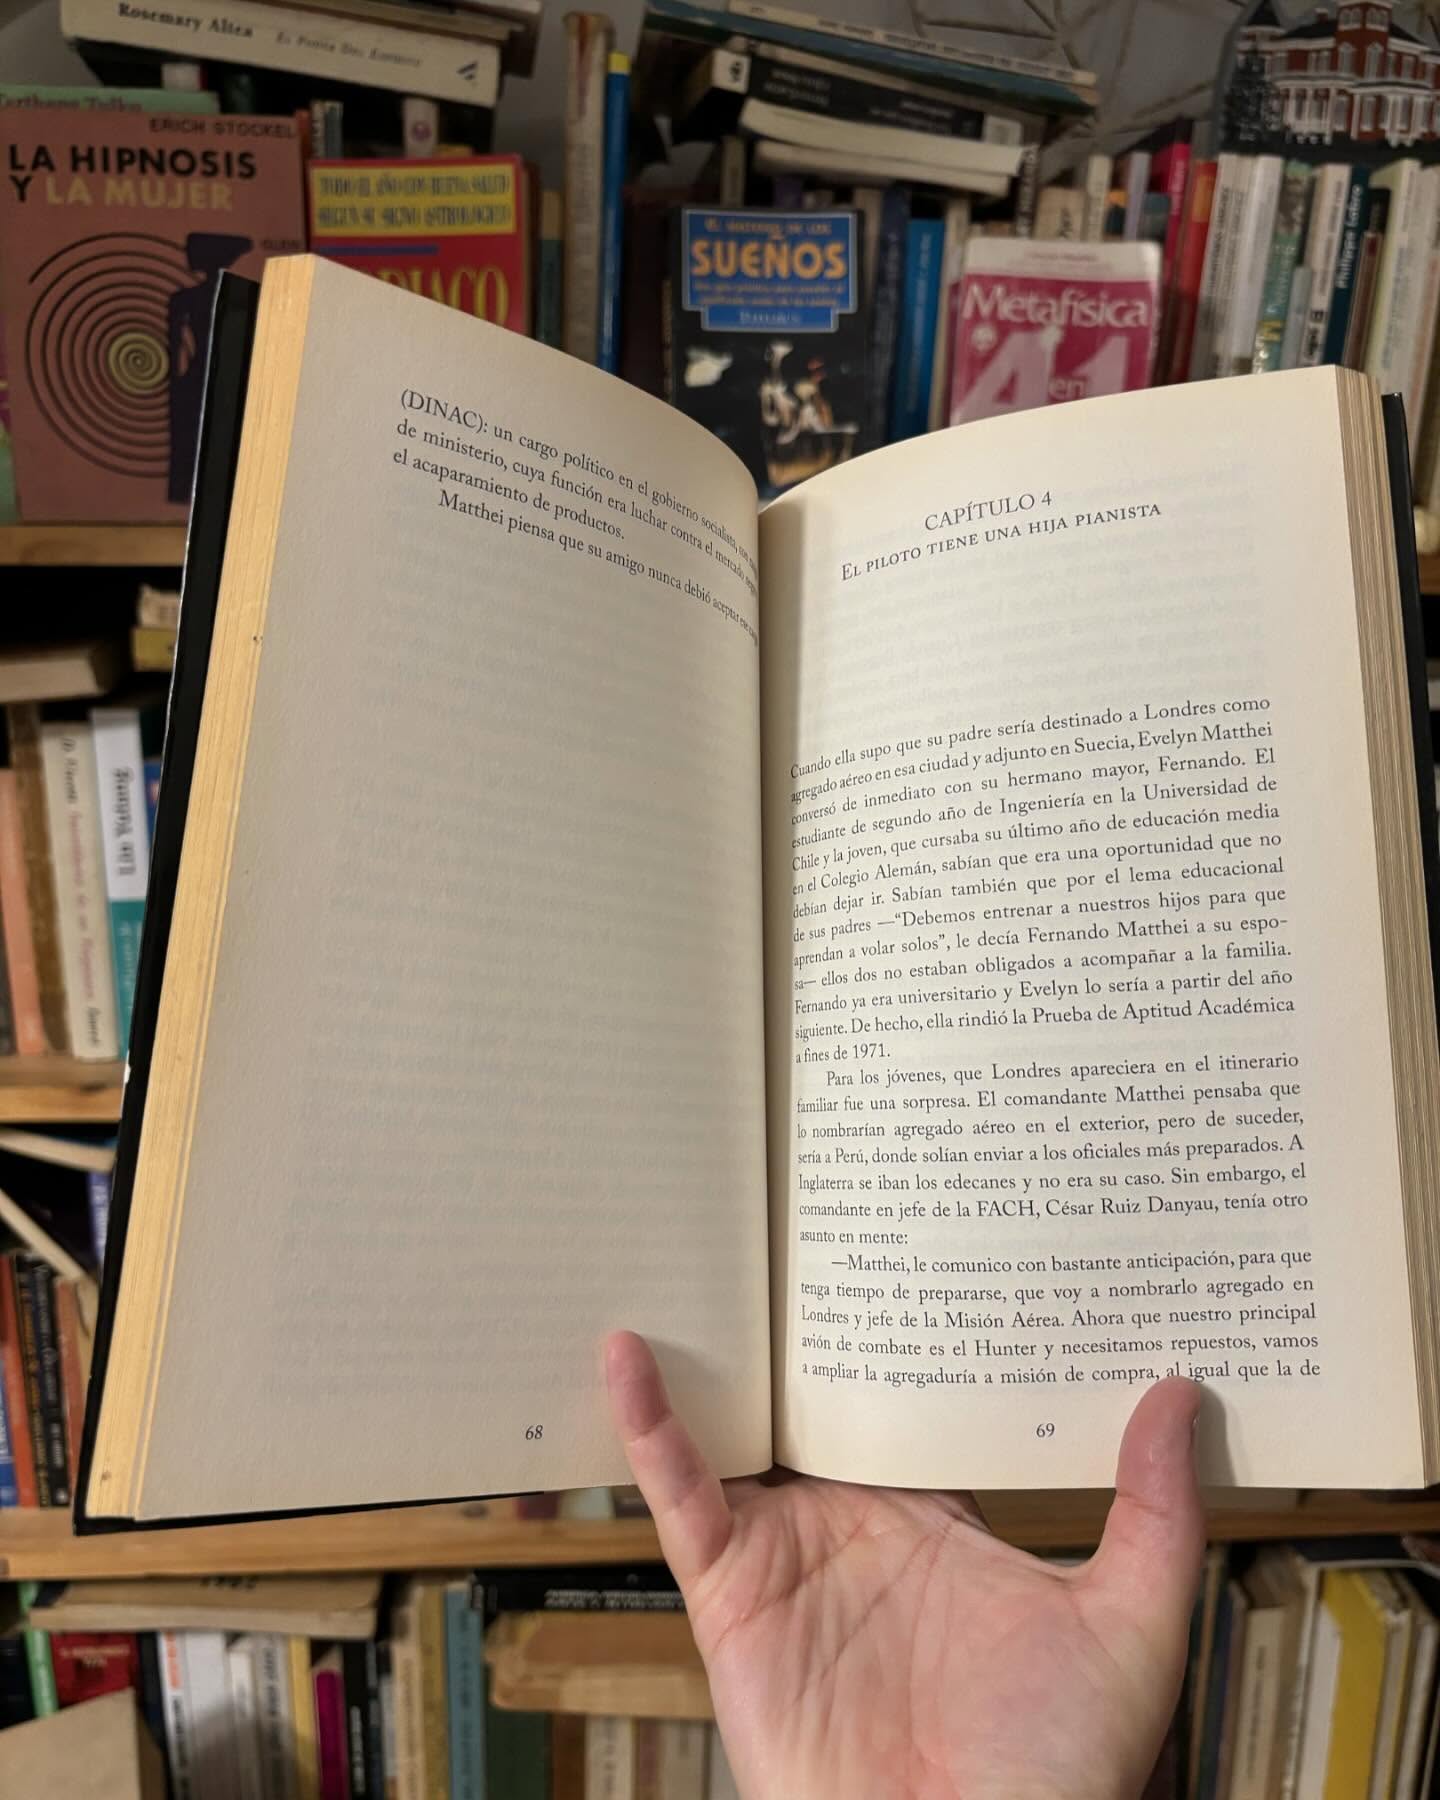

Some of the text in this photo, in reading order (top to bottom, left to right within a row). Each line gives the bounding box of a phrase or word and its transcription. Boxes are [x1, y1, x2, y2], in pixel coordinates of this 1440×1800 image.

[118, 2, 202, 33] Rosemary
[150, 117, 206, 134] ERICH
[9, 145, 258, 180] LA HIPNOSIS
[10, 175, 233, 210] Y LA MUJER
[691, 233, 847, 280] SUEÑOS
[961, 282, 1148, 329] Metafísica
[401, 388, 488, 434] (DINAC):
[494, 425, 513, 442] un
[519, 435, 558, 460] cargo
[563, 452, 614, 480] político
[618, 474, 633, 490] en
[638, 481, 648, 496] el
[652, 490, 699, 522] gobierno
[393, 449, 625, 540] el acaparamiento de productos.
[397, 418, 417, 438] de
[423, 430, 508, 471] ministerio,
[512, 461, 545, 483] cuya
[551, 470, 603, 504] función
[607, 496, 626, 513] era
[631, 501, 667, 531] luchar
[670, 524, 702, 549] contra
[705, 542, 713, 556] el
[924, 490, 1052, 532] CAPÍTULO 4
[438, 489, 503, 525] Matthei
[508, 515, 555, 542] piensa
[559, 533, 584, 551] que
[587, 543, 602, 558] su
[606, 550, 645, 576] amigo
[648, 567, 682, 590] nunca
[684, 579, 711, 604] debió
[791, 699, 1270, 778] Cuando ella supo que su padre sería destinado a Londres como
[792, 776, 1277, 850] estudiante de segundo año de Ingeniería en la Universidad de
[793, 856, 1284, 920] debían dejar ir. Sabían también que por el lema educacional
[796, 997, 1295, 1043] siguiente. De hecho, ella rindió la Prueba de Aptitud Académica
[796, 1043, 890, 1063] a fines de 1971.
[797, 1081, 1300, 1114] familiar fue una sorpresa. El comandante Matthei pensaba que
[800, 1193, 1308, 1222] comandante en jefe de la FACH, César Ruiz Danyau, tenía otro
[802, 1302, 1316, 1331] Londres y jefe de la Misión Aérea. Ahora que nuestro principal
[525, 1424, 543, 1440] 68
[1036, 1422, 1055, 1438] 69
